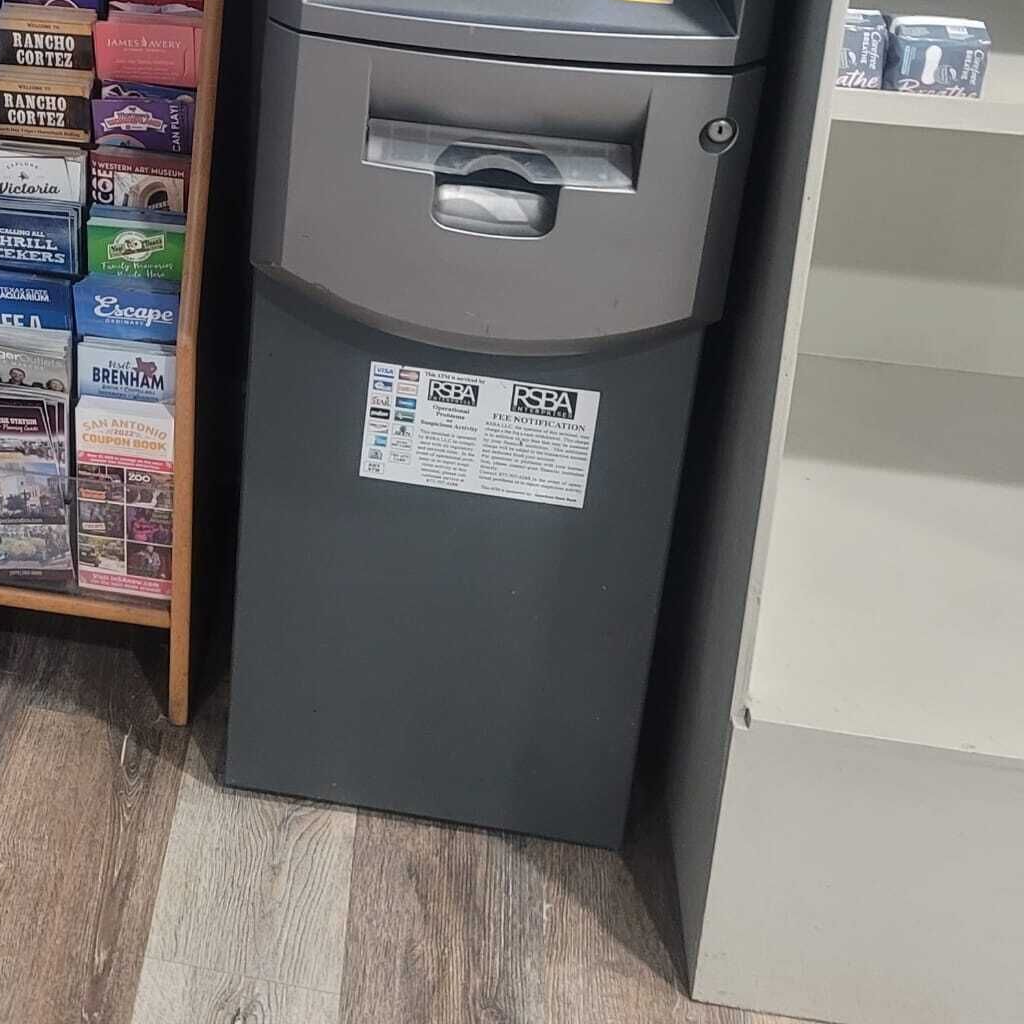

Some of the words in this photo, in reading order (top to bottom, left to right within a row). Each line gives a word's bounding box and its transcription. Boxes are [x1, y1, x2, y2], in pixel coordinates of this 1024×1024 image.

[12, 31, 75, 50] RANCHO
[106, 38, 141, 48] JAMES
[147, 40, 182, 49] AVERY
[16, 50, 73, 68] CORTEZ
[3, 92, 67, 112] RANCHO
[7, 109, 65, 127] CORTEZ
[98, 162, 133, 172] WESTERN
[135, 165, 149, 174] ART
[151, 168, 185, 177] MUSEUM
[0, 227, 29, 236] CALLING
[30, 230, 46, 238] ALL
[0, 293, 50, 302] AQUARIUM
[94, 295, 174, 327] Escape
[92, 366, 164, 390] BRENHAM
[430, 381, 476, 401] RSBA
[513, 385, 574, 415] RSBA
[493, 413, 511, 421] FEE
[514, 415, 586, 432] NOTIFICATION
[82, 434, 131, 448] COUPON
[133, 438, 167, 451] BOOK
